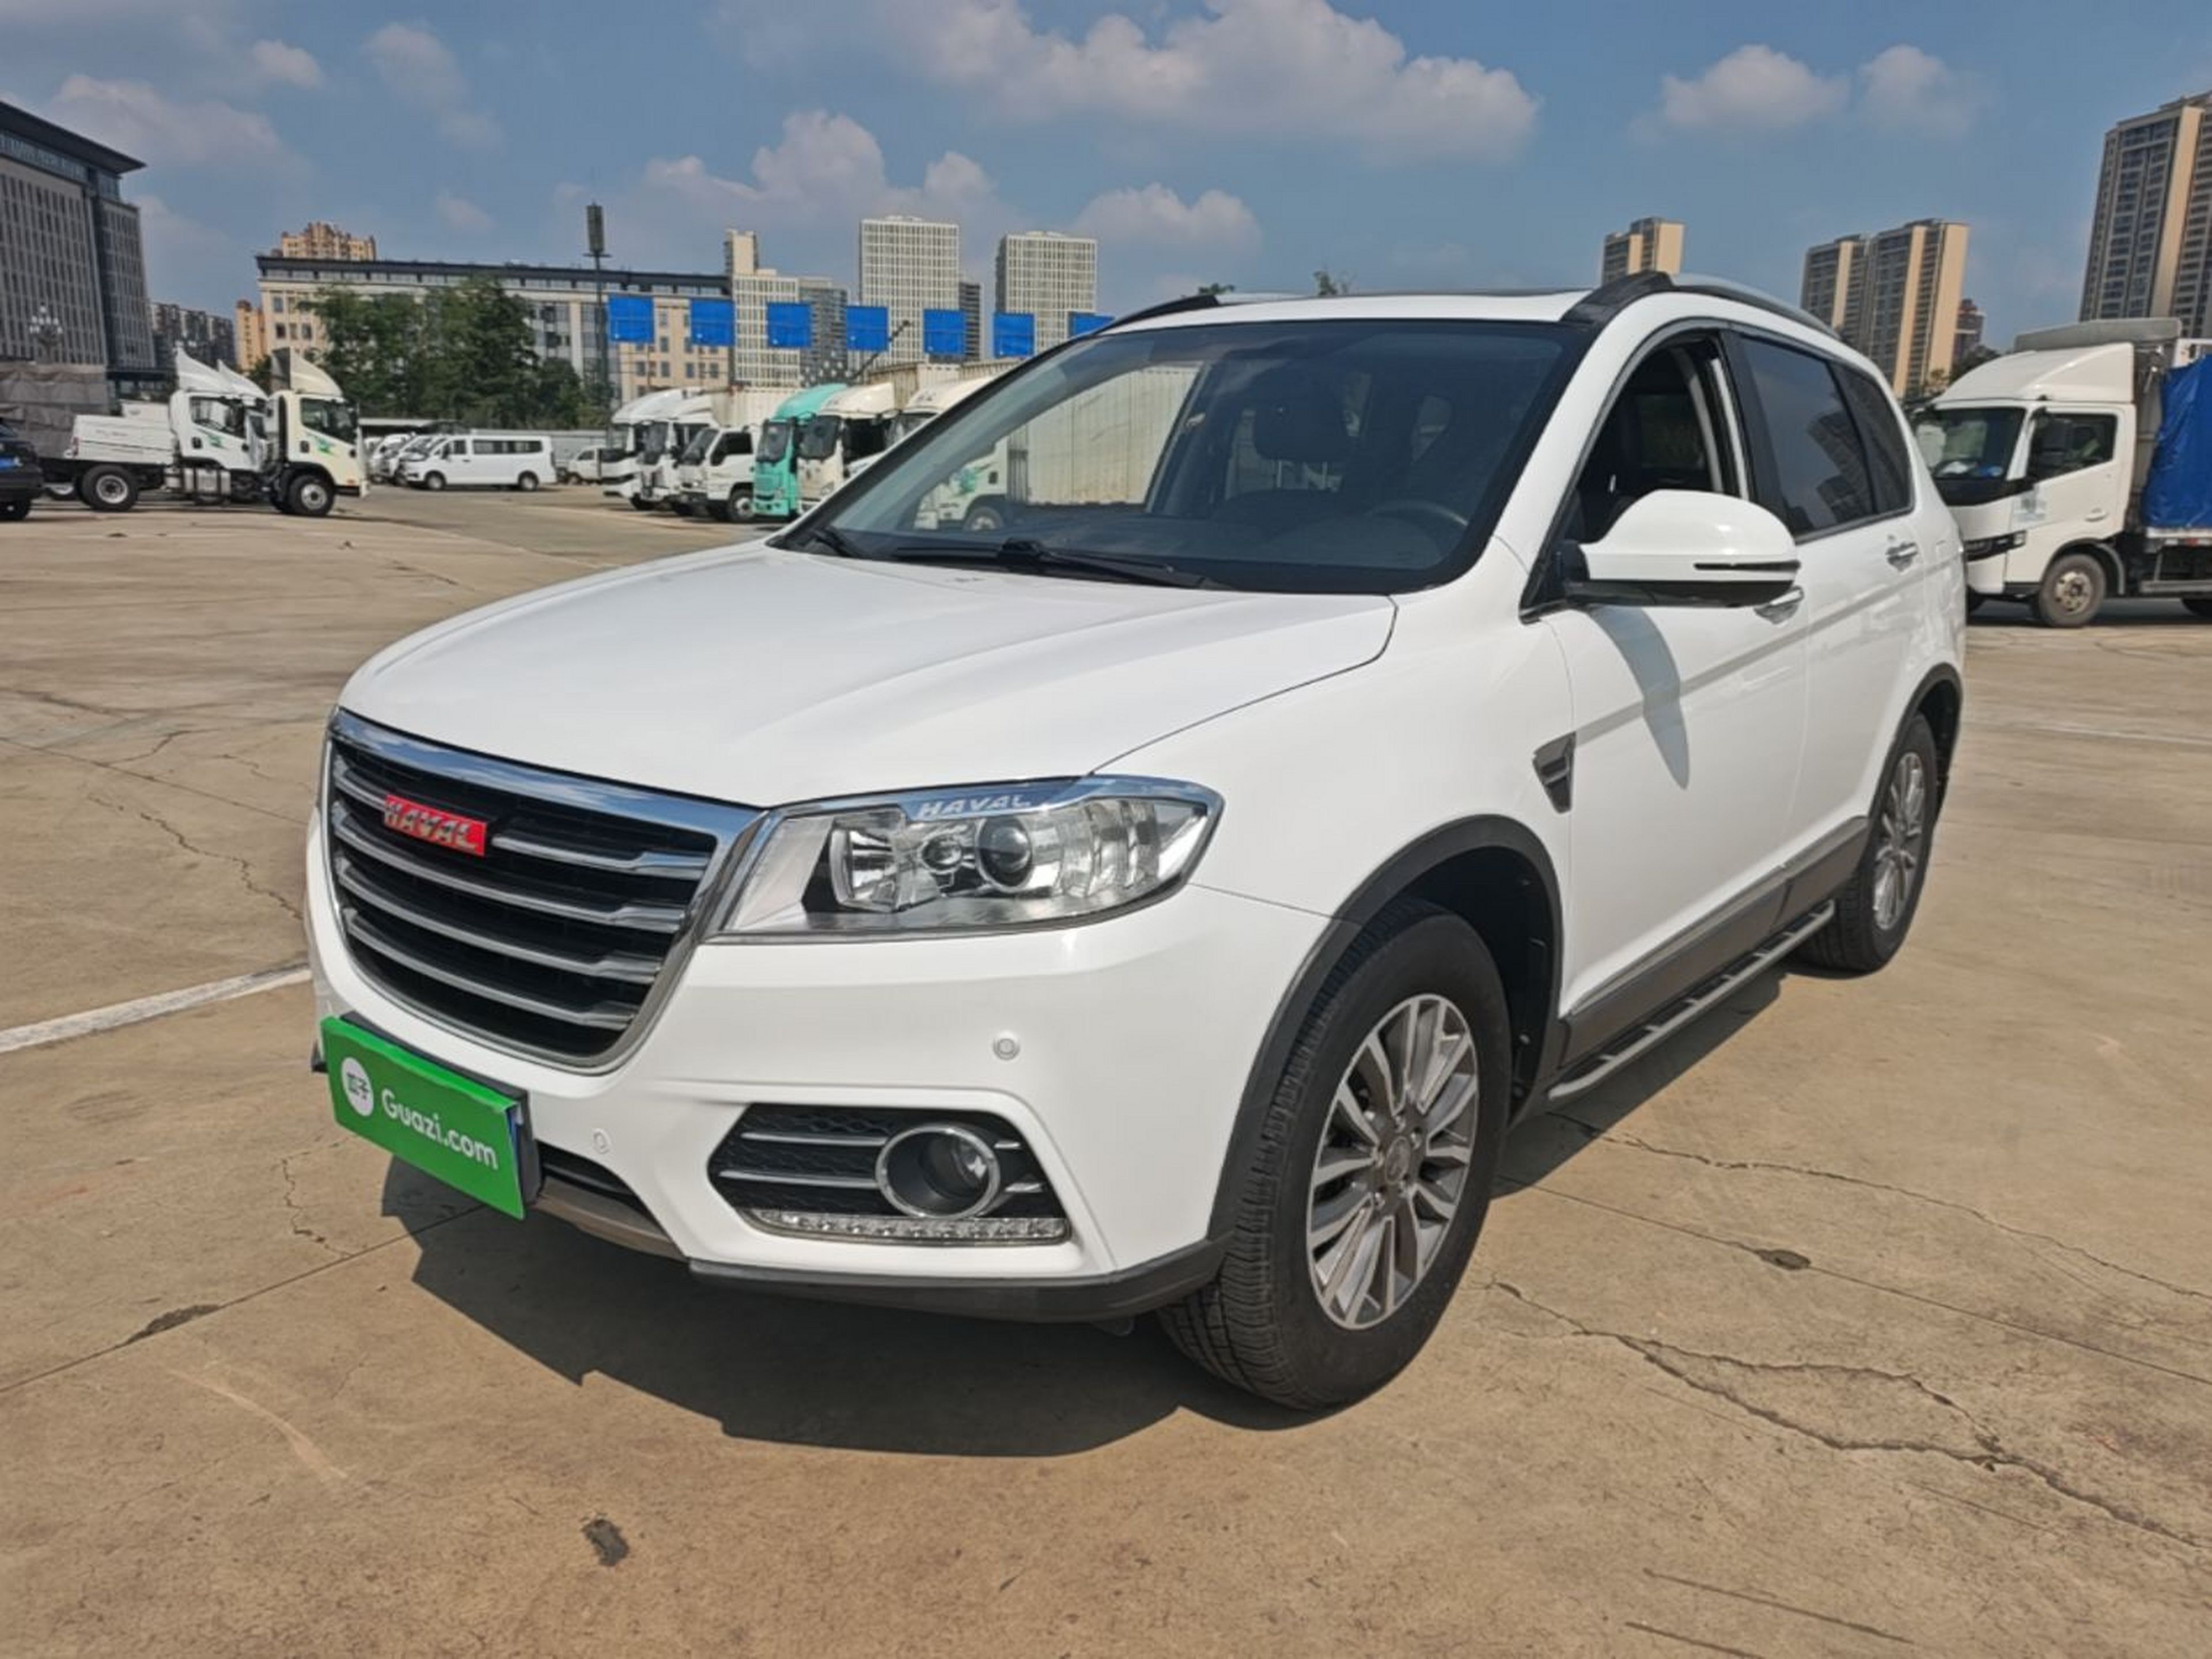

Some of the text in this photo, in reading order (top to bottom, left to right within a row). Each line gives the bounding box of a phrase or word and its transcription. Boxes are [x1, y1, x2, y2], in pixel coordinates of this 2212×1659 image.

[385, 801, 476, 850] HAVAL
[918, 795, 1031, 819] HAVAL
[381, 1088, 498, 1170] Guazi.com
